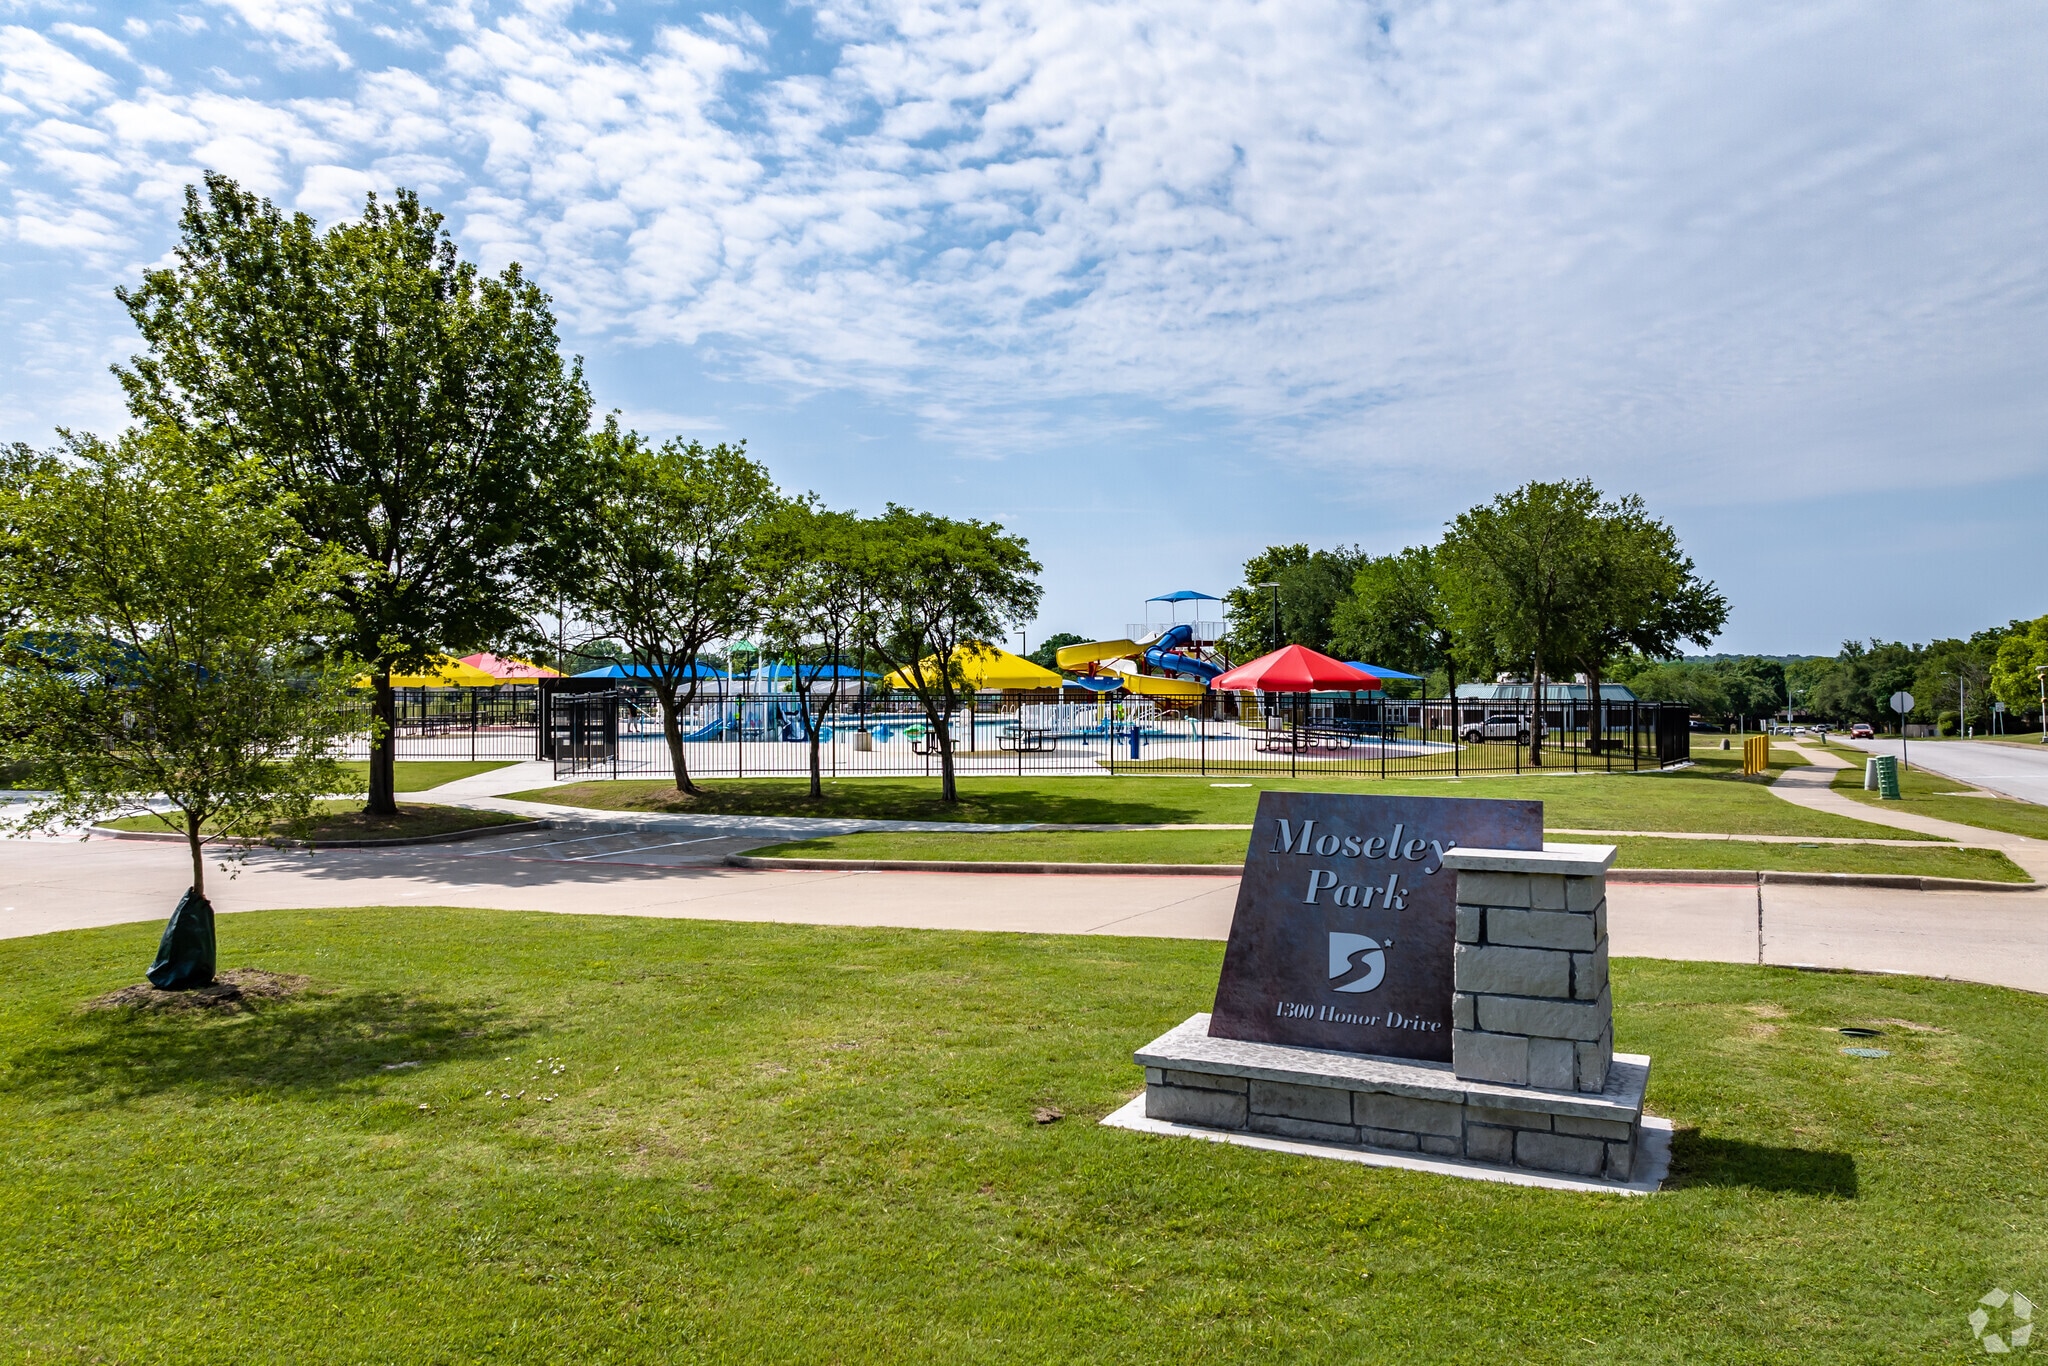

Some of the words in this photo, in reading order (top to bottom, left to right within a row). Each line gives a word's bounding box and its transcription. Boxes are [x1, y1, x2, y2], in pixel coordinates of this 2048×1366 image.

[1269, 818, 1456, 874] Moseley
[1302, 869, 1409, 910] Park
[1276, 1001, 1315, 1019] 1300
[1319, 1005, 1380, 1026] Honor
[1386, 1011, 1442, 1033] Drive
